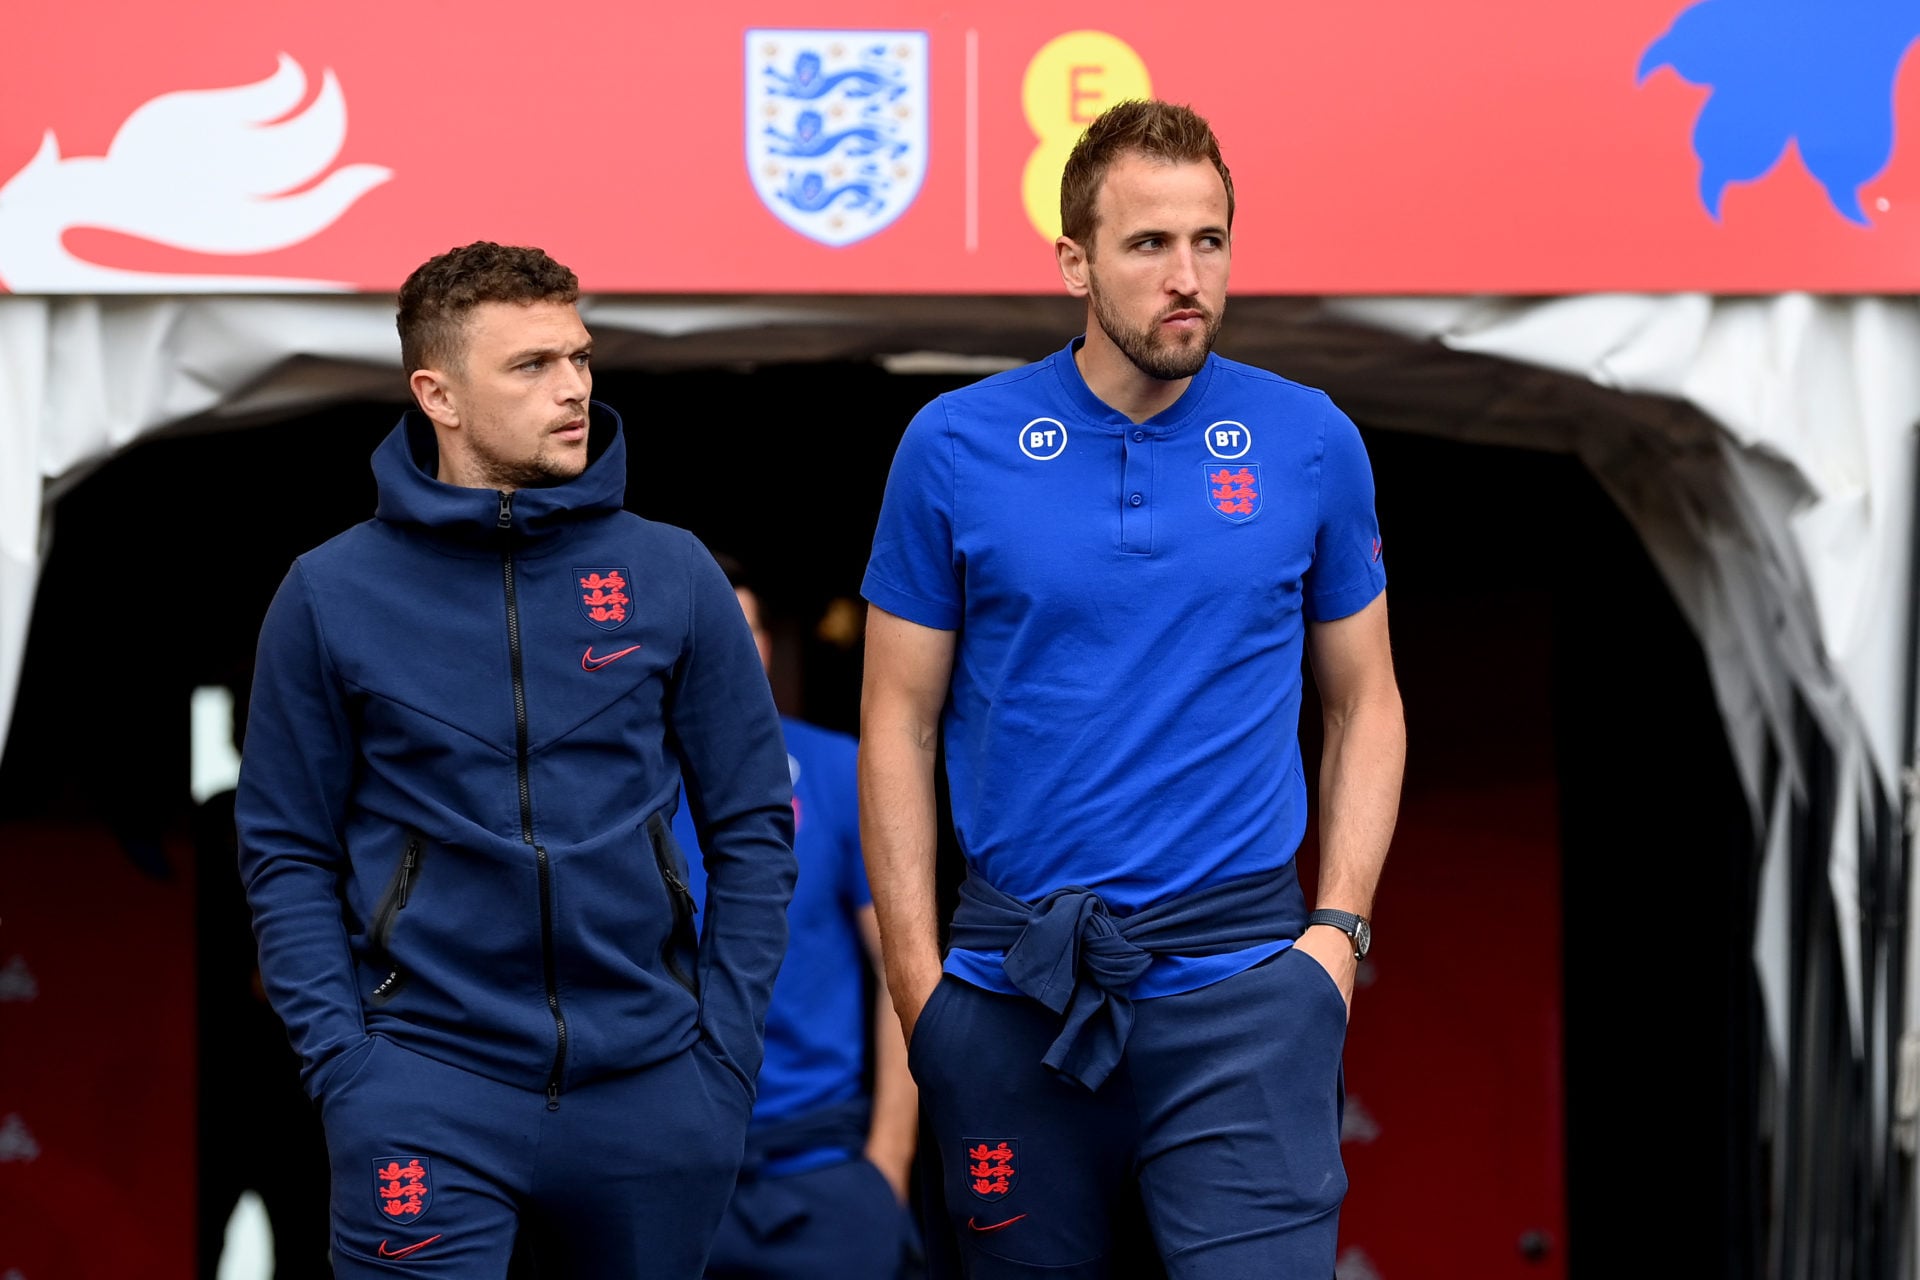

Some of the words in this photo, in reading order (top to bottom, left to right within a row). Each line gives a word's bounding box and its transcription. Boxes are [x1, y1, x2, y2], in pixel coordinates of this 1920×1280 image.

[1069, 65, 1105, 123] E
[1030, 430, 1057, 448] BT
[1215, 430, 1241, 448] BT
